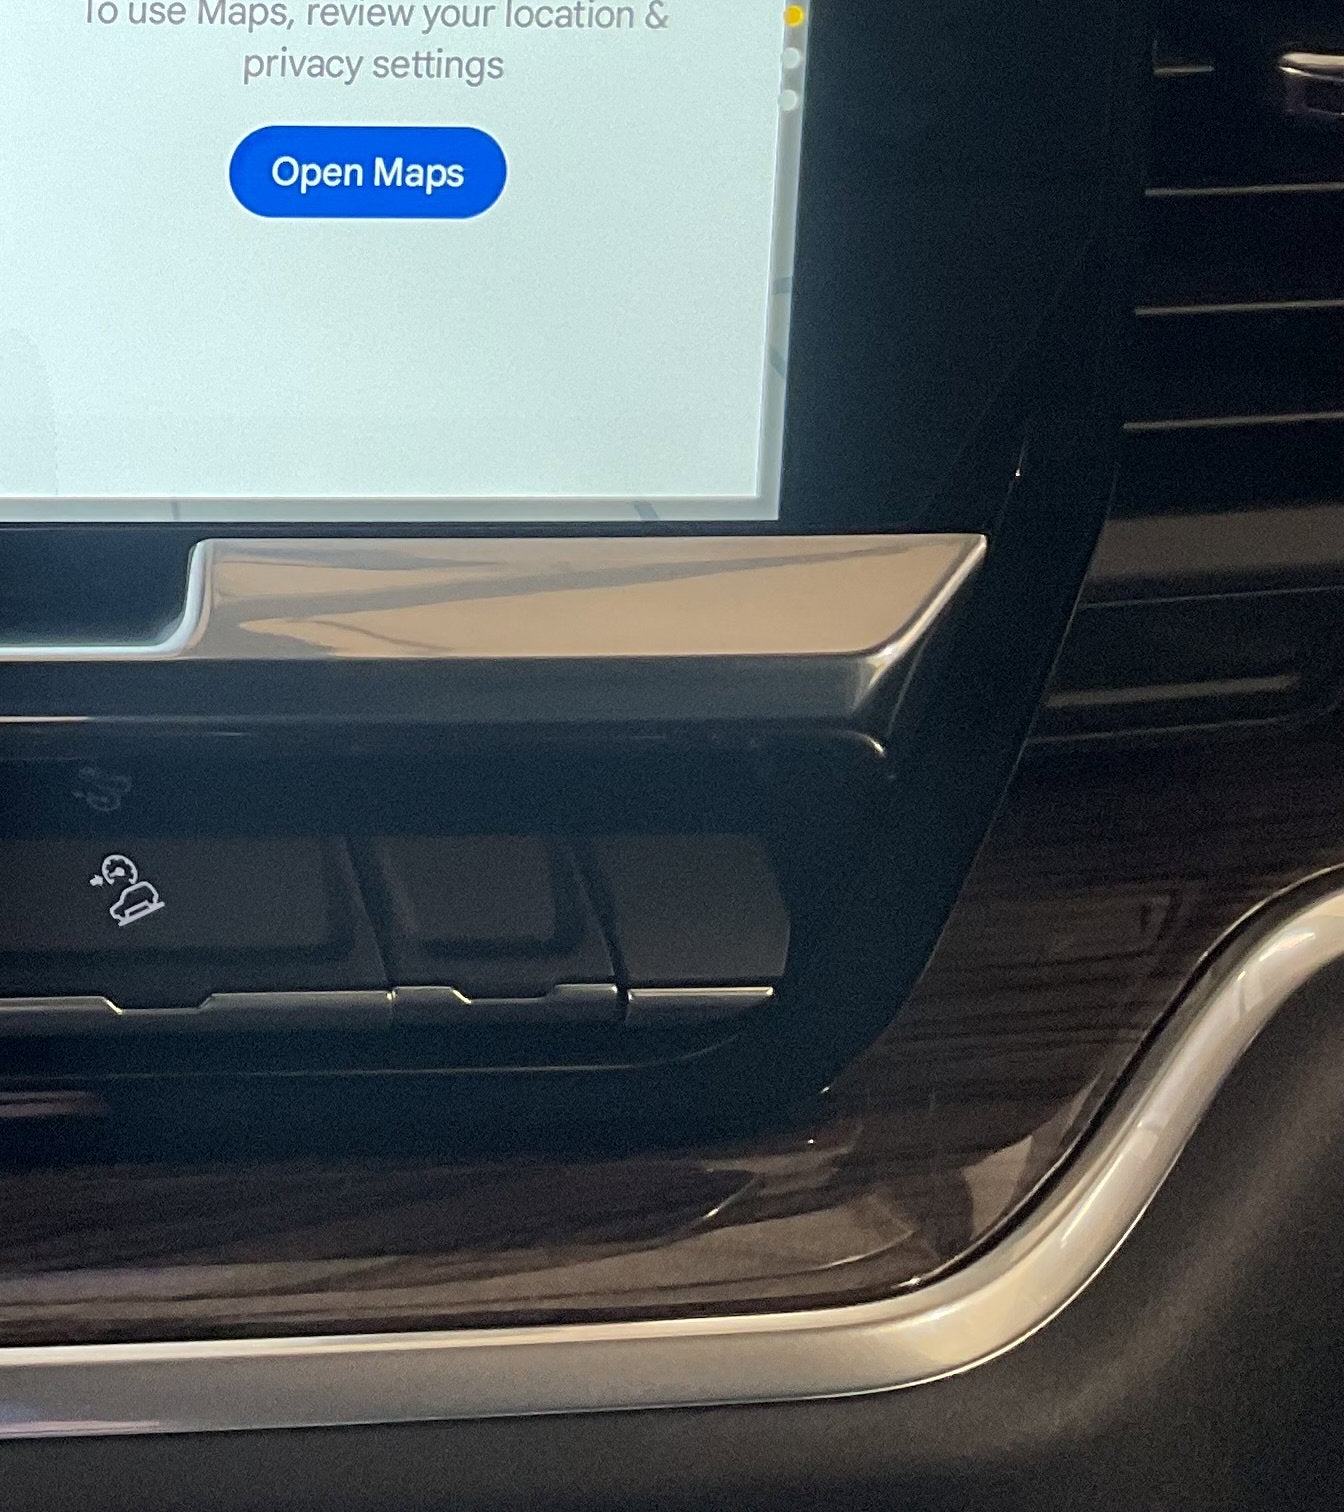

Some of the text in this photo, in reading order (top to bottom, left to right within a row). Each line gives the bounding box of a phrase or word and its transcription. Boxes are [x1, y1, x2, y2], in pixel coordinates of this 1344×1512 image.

[129, 2, 186, 25] use
[422, 5, 496, 35] your
[645, 0, 668, 29] &
[244, 46, 504, 87] privacy settings
[272, 156, 464, 194] Open Maps
